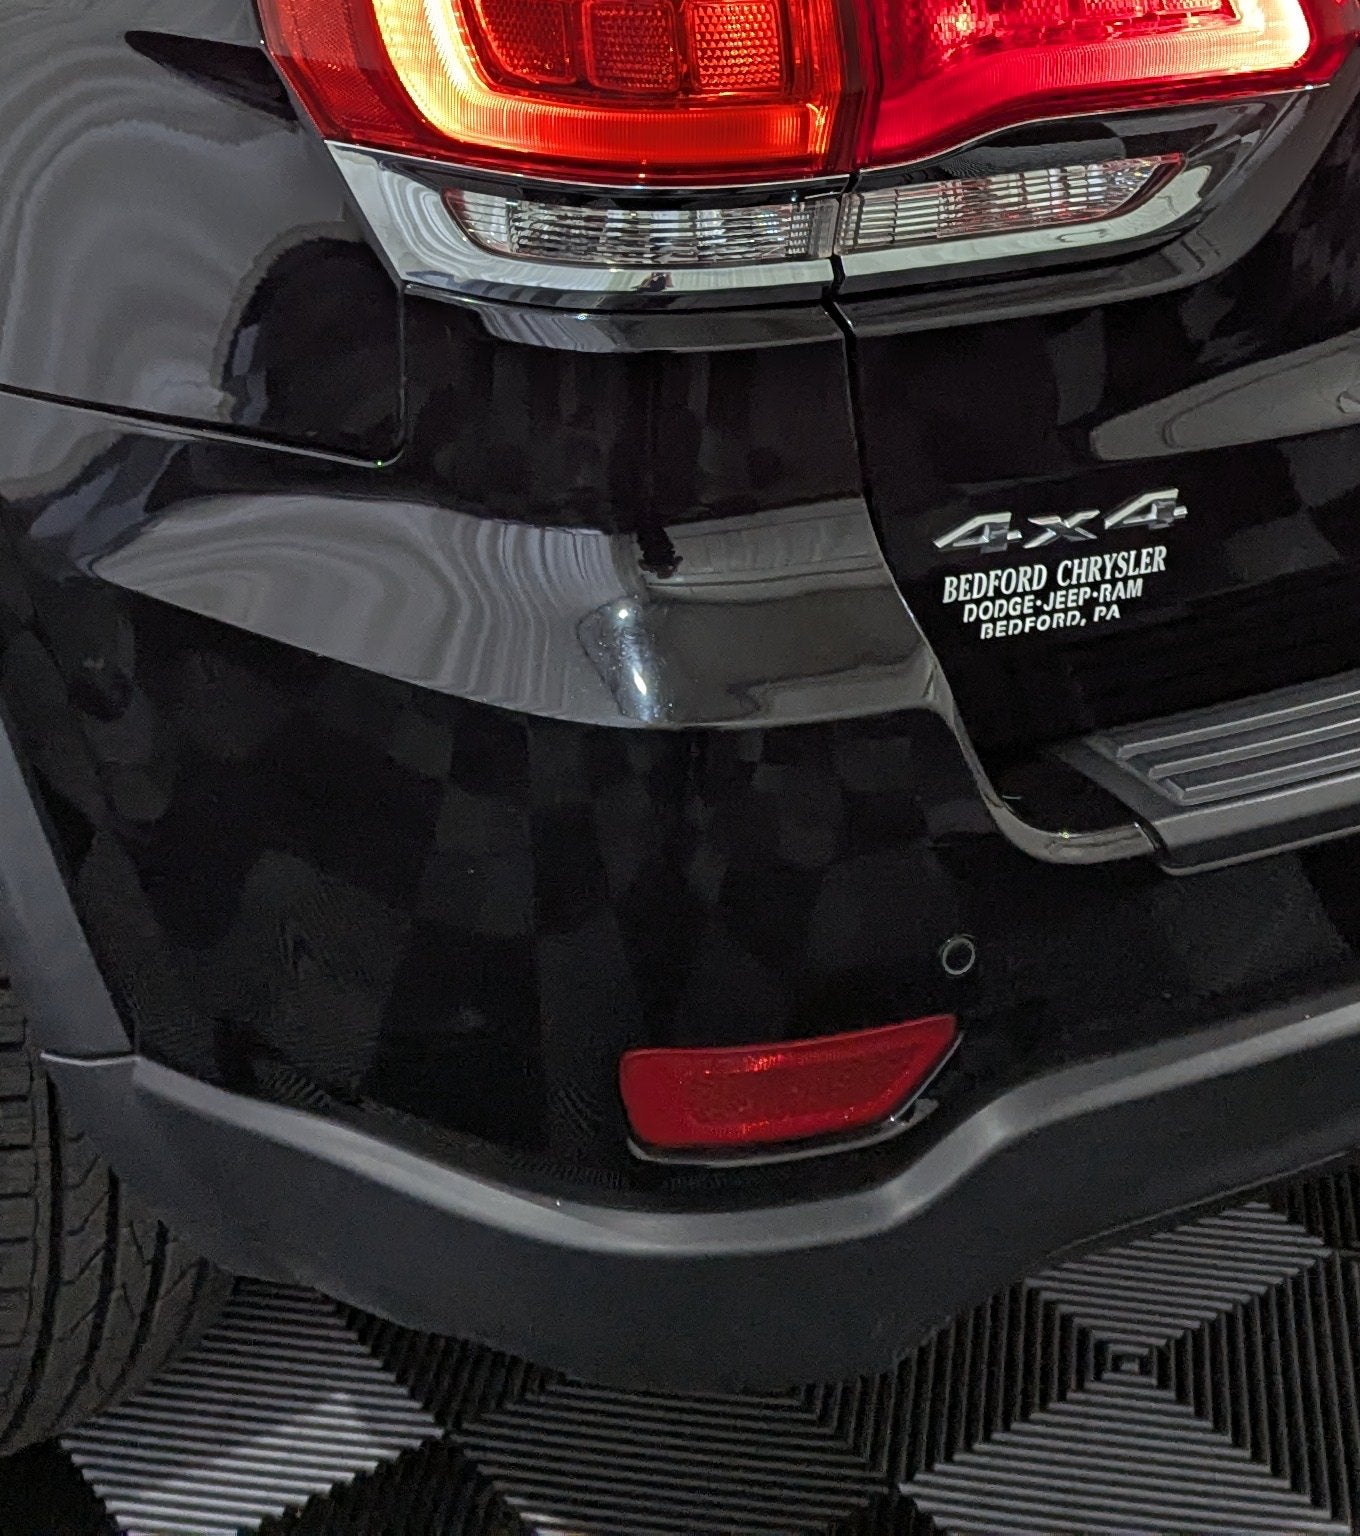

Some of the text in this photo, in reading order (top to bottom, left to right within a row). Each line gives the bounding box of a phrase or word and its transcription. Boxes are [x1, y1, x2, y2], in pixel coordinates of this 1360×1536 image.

[942, 546, 1168, 604] BEDFORD CHRYSLER
[980, 604, 1121, 640] BEDFORD, PA
